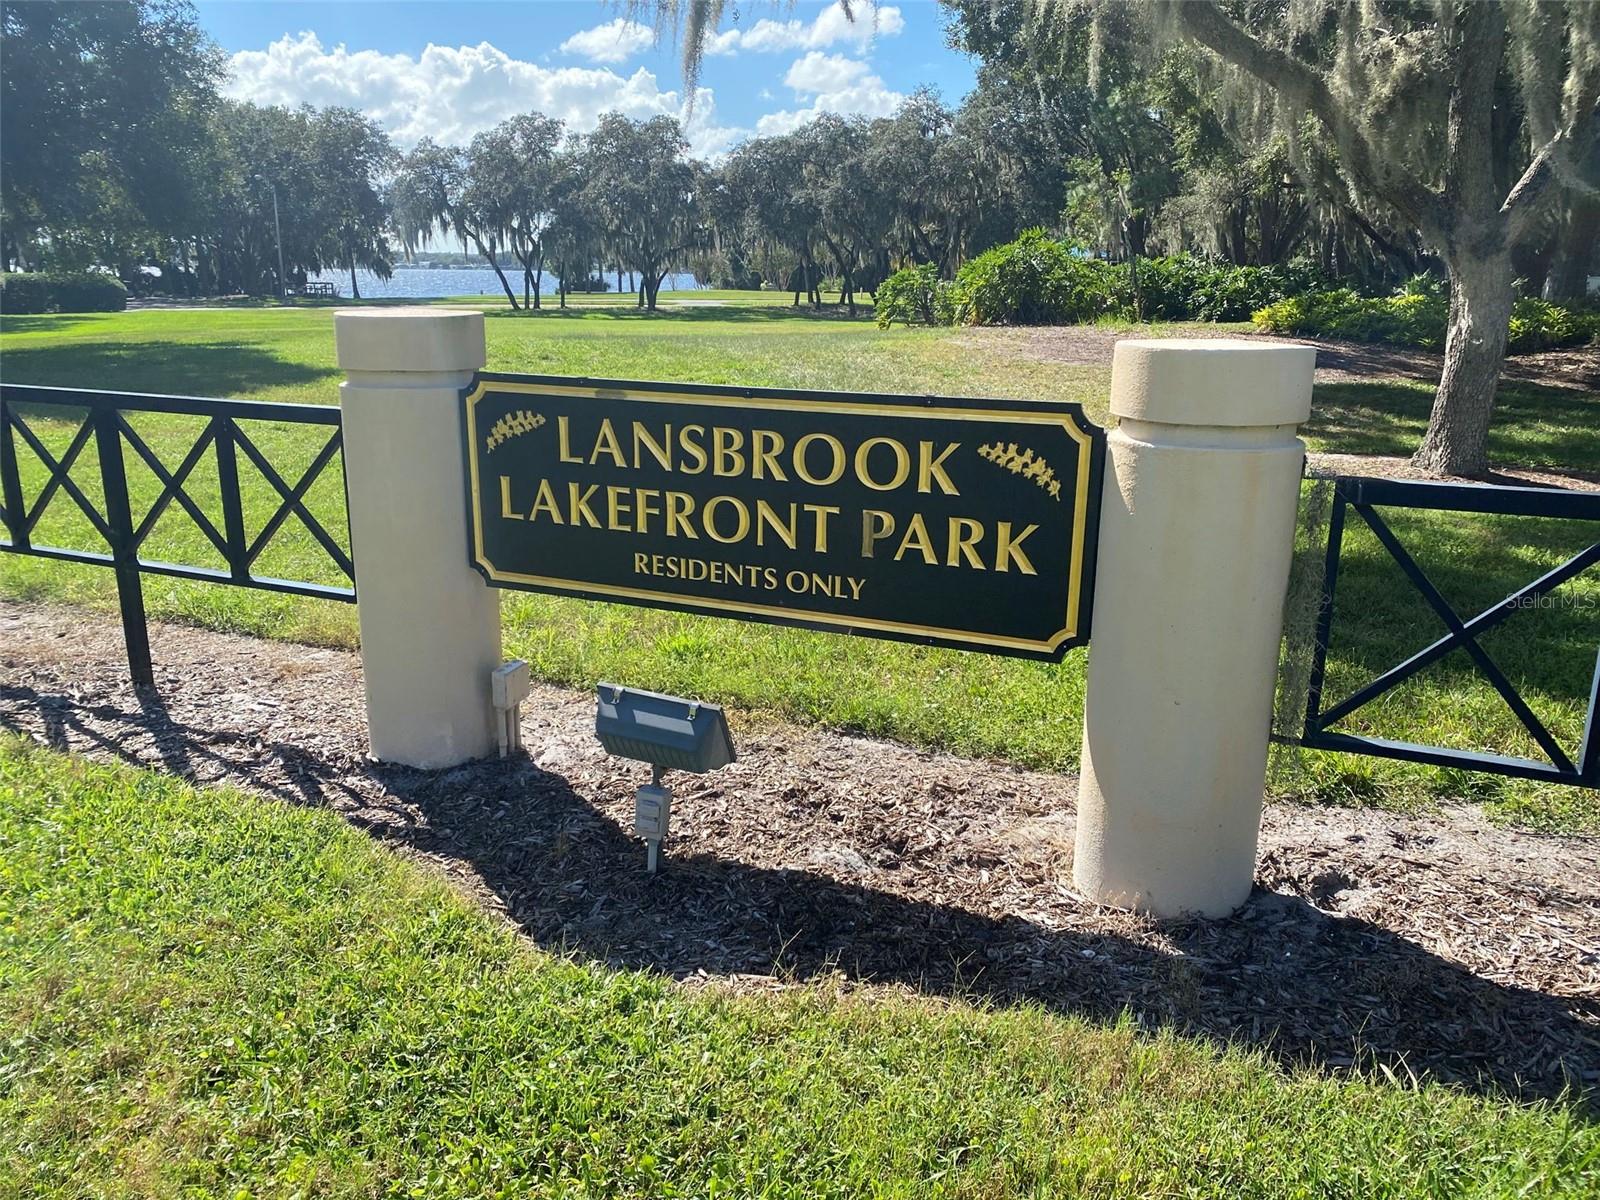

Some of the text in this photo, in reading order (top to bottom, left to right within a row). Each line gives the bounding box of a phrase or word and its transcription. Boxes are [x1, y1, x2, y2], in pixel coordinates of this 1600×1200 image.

[557, 415, 961, 496] LANSBROOK
[498, 475, 1040, 576] LAKEFRONT PARK
[634, 552, 866, 600] RESIDENTS ONLY
